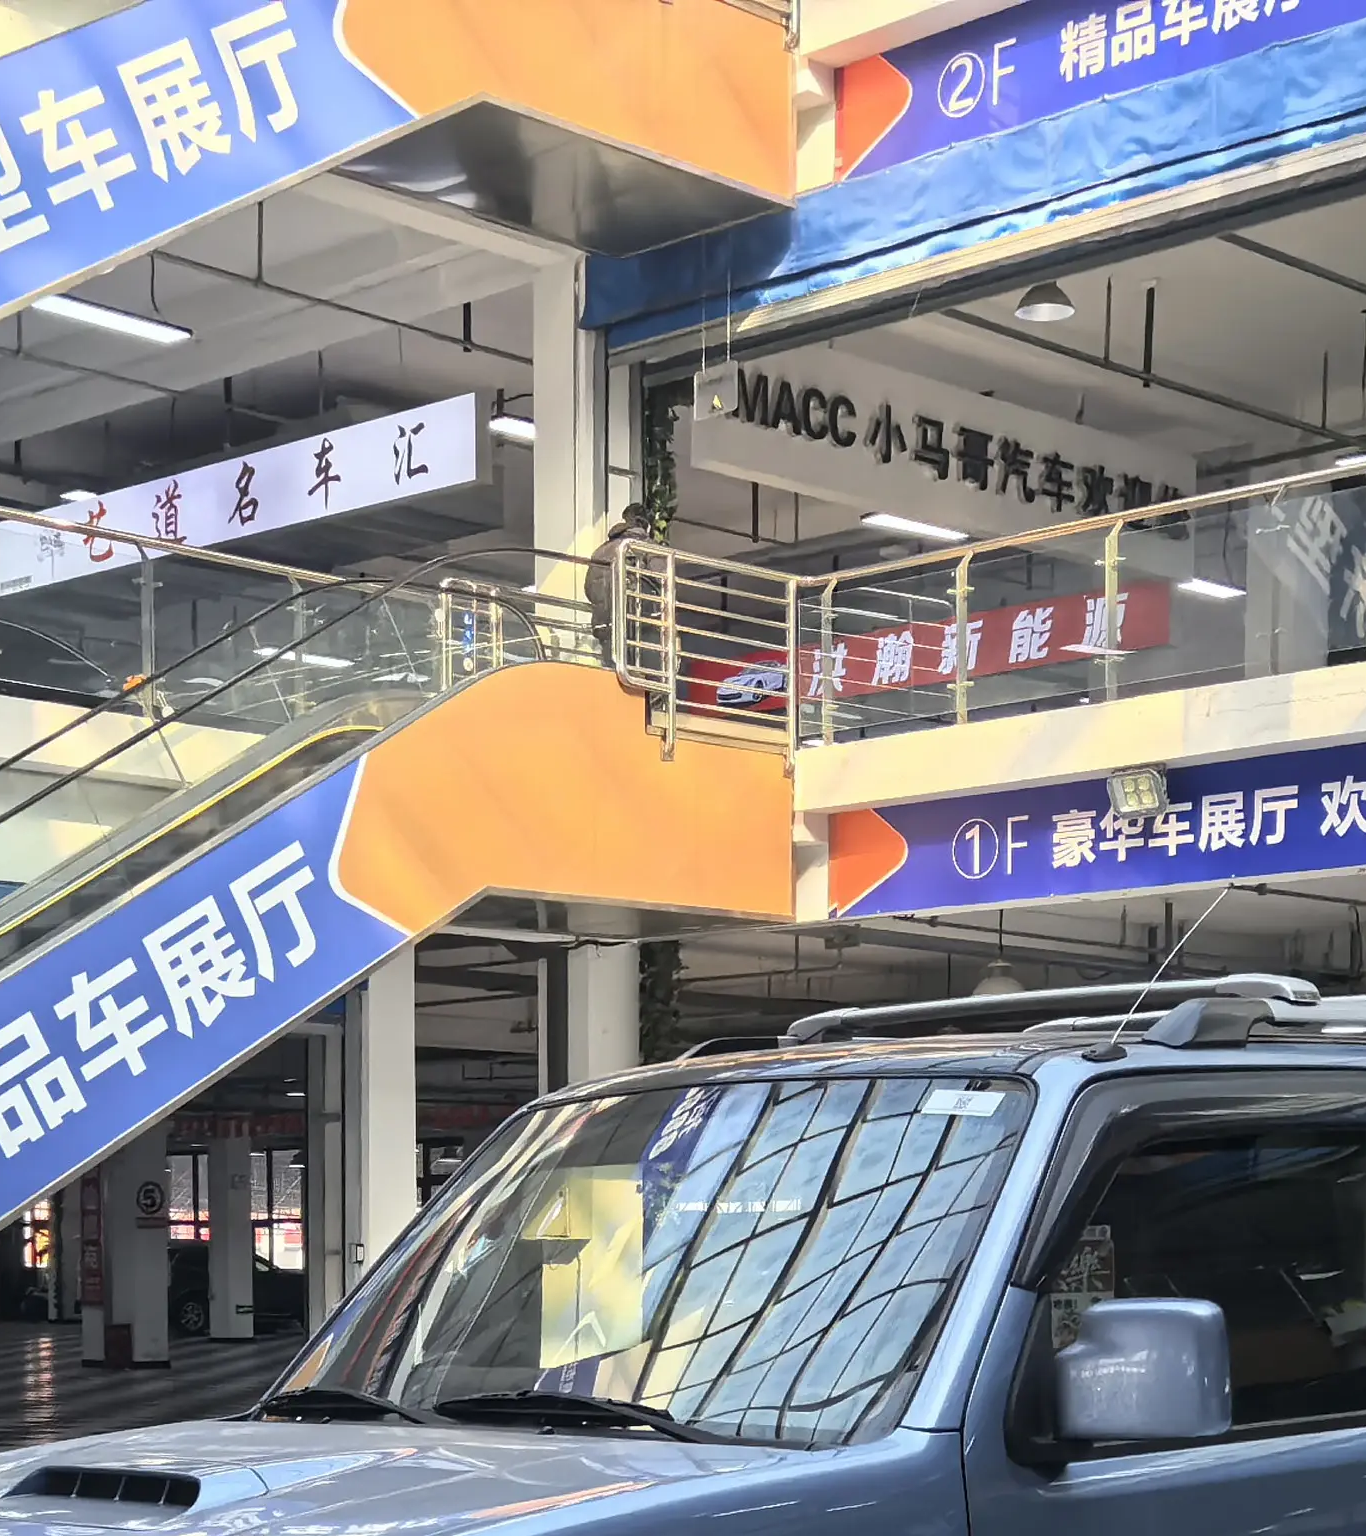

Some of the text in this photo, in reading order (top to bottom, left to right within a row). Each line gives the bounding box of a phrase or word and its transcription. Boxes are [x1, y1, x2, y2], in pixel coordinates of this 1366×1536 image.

[1051, 784, 1300, 869] 豪华车展厅
